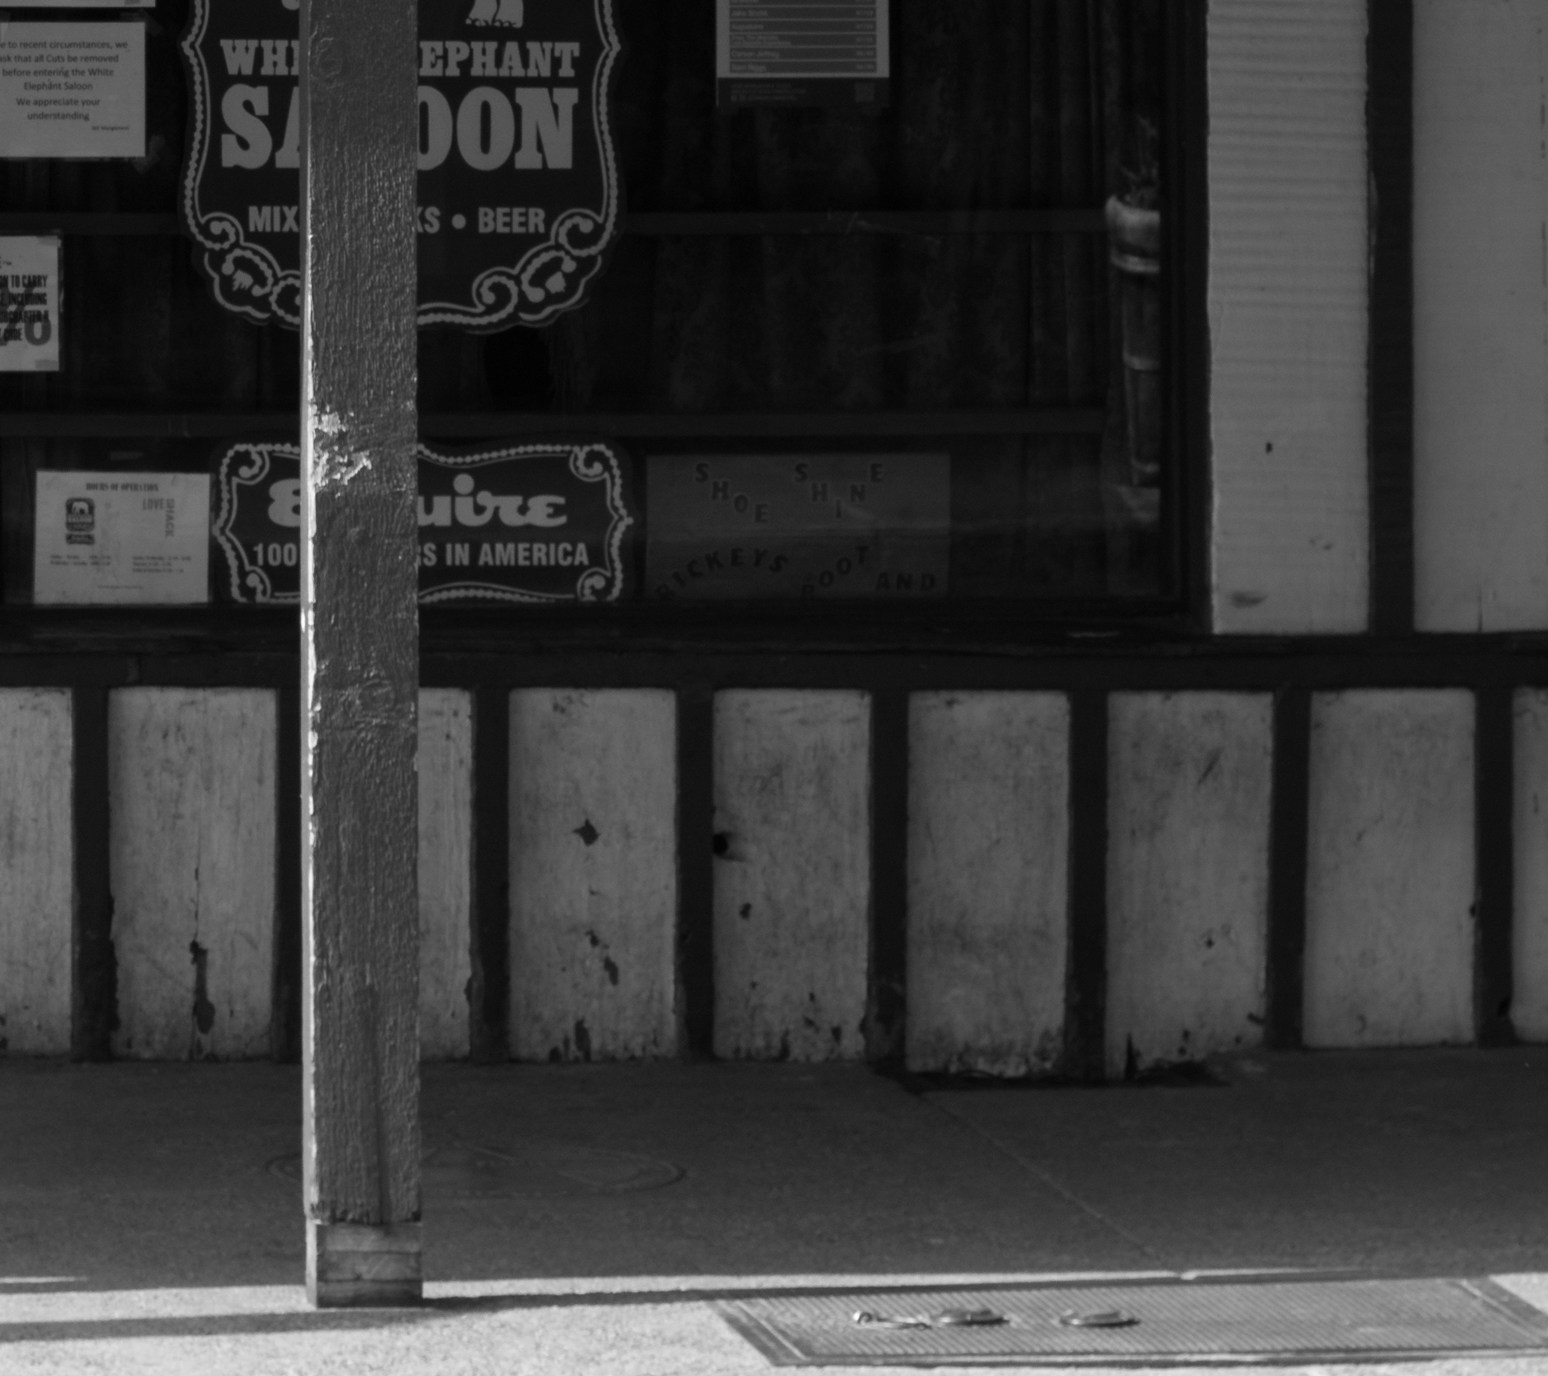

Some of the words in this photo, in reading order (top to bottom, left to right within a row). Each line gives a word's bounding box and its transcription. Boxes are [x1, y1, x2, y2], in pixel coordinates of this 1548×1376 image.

[8, 40, 18, 49] to
[19, 40, 46, 49] recent
[115, 40, 128, 49] we
[14, 54, 32, 63] that
[34, 54, 44, 63] all
[67, 54, 78, 63] be
[80, 54, 119, 63] removed
[419, 41, 580, 77] EPHANT
[2, 68, 31, 78] before
[33, 68, 69, 78] entering
[71, 68, 86, 78] the
[87, 68, 114, 78] White
[23, 82, 62, 91] Elephant
[64, 82, 93, 91] Saloon
[16, 98, 30, 108] We
[33, 98, 79, 108] appreciate
[81, 98, 101, 108] your
[27, 112, 90, 121] understanding
[478, 207, 545, 234] BEER
[696, 462, 769, 524] SHOE
[794, 462, 884, 520] SHINE
[143, 498, 164, 510] LOVE
[446, 543, 470, 566] IN
[478, 543, 590, 567] AMERICA
[876, 572, 936, 591] AND
